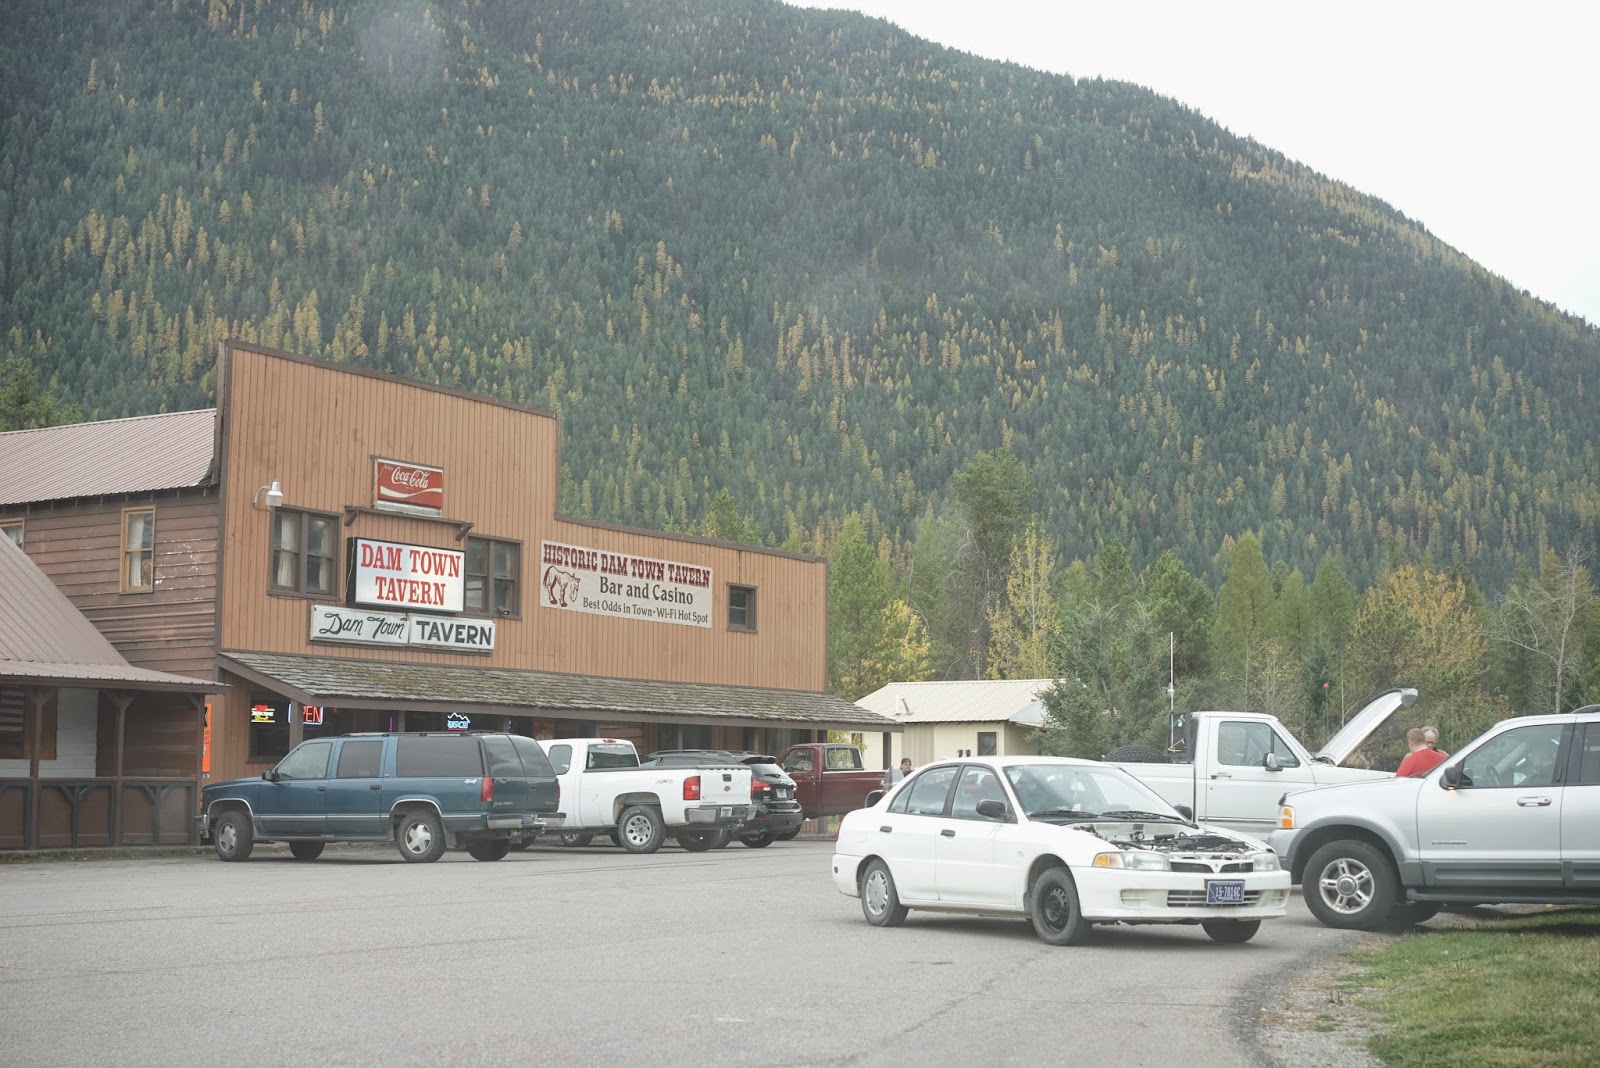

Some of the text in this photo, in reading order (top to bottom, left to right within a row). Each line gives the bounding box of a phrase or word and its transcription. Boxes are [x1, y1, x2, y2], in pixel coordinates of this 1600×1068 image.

[391, 466, 430, 489] Coca-Cola
[361, 543, 461, 578] DAM TOWN
[543, 543, 711, 588] HISTORIC DAM TOWN TAVERN
[375, 576, 446, 606] TAVERN
[600, 576, 694, 605] Bar and Casino
[583, 597, 709, 625] Best Odds in Town Wi-Fi Hot Spot
[319, 612, 492, 646] Dam Town TAVERN
